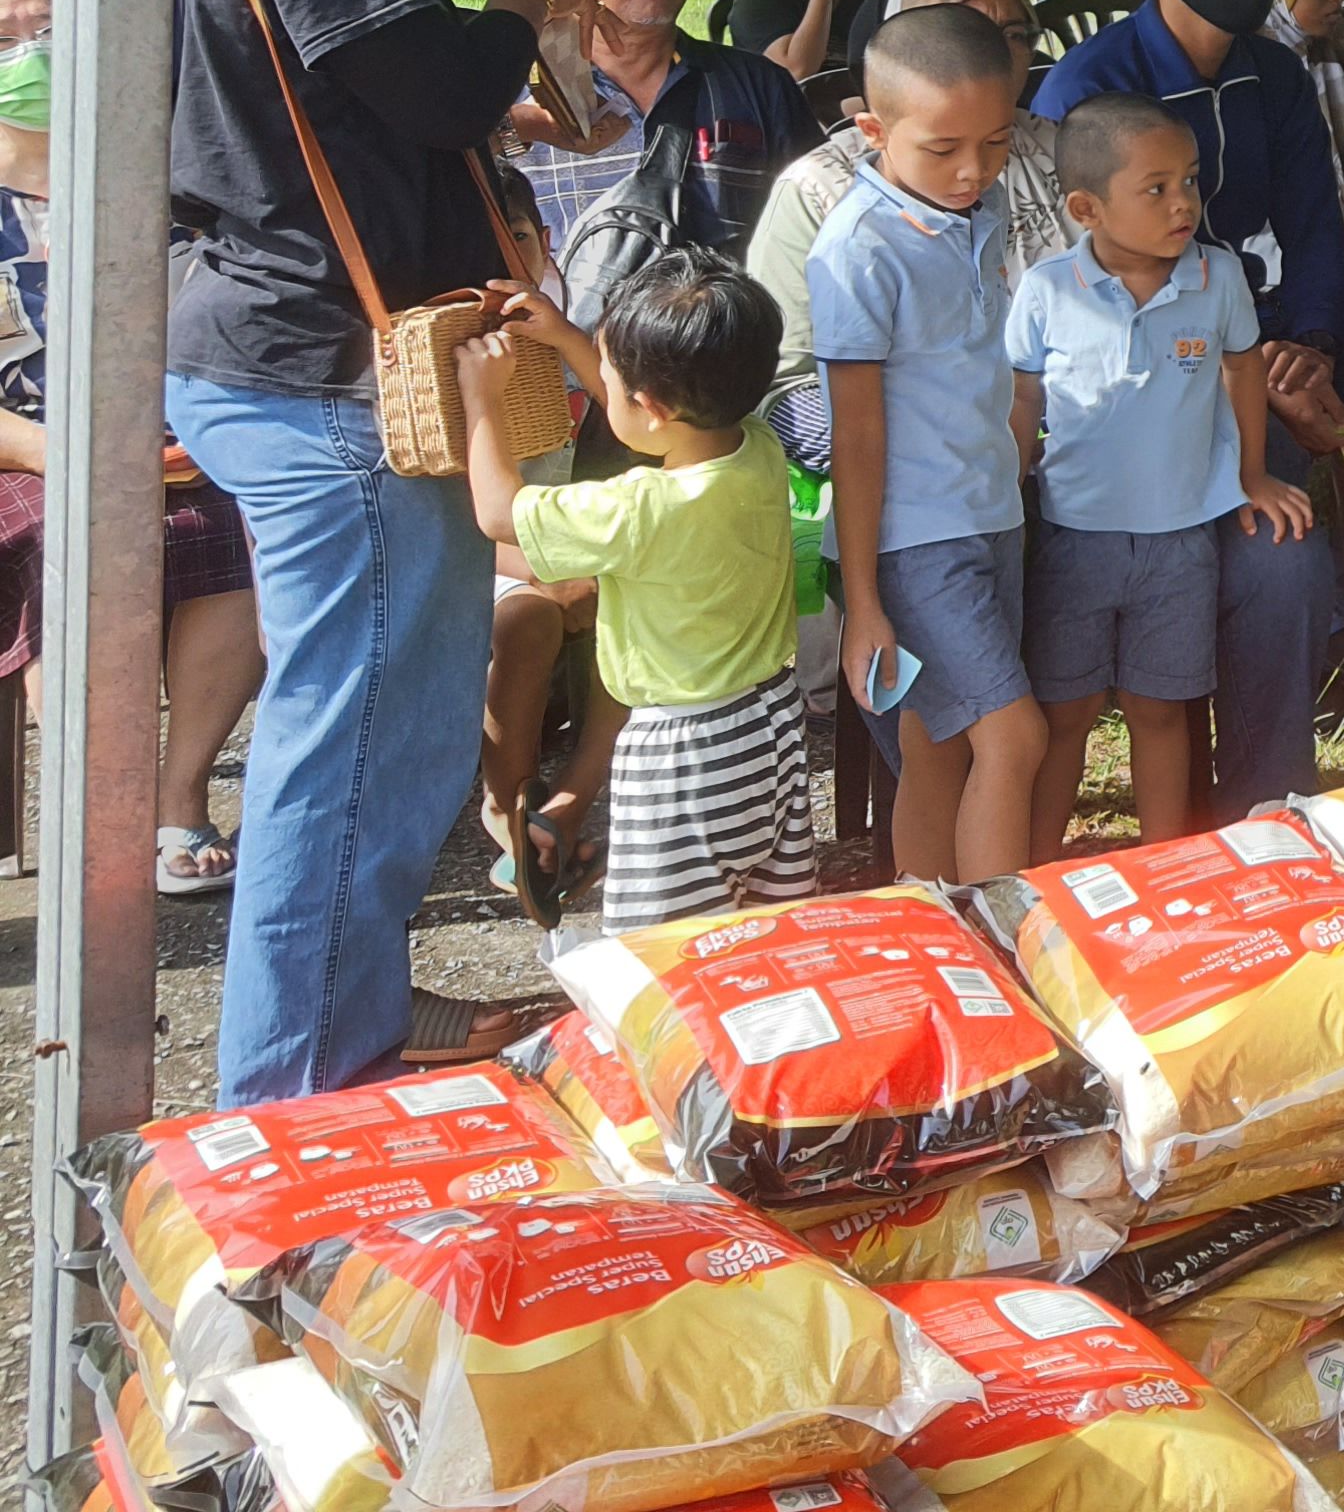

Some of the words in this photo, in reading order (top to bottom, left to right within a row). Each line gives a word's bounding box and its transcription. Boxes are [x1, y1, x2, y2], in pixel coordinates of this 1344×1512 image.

[1175, 339, 1207, 358] 92
[695, 919, 760, 949] Ehsan
[698, 928, 759, 958] PKPS
[1200, 927, 1278, 964] Tempatan
[1238, 935, 1284, 958] Super
[1179, 957, 1236, 983] Special
[1229, 945, 1292, 973] Beras
[467, 1157, 534, 1188] PKPS
[467, 1169, 540, 1201] Ehsan
[323, 1176, 424, 1201] Tempatan
[369, 1187, 427, 1202] Super
[293, 1196, 366, 1222] Special
[355, 1196, 432, 1219] Beras
[550, 1250, 660, 1281] Tempatan
[601, 1258, 664, 1278] Super
[708, 1240, 786, 1278] Ehsan
[518, 1275, 598, 1308] Special
[587, 1269, 673, 1295] Beras
[1122, 1378, 1183, 1402] PKPS
[1127, 1387, 1191, 1409] Ehsan
[964, 1403, 1033, 1429] Special
